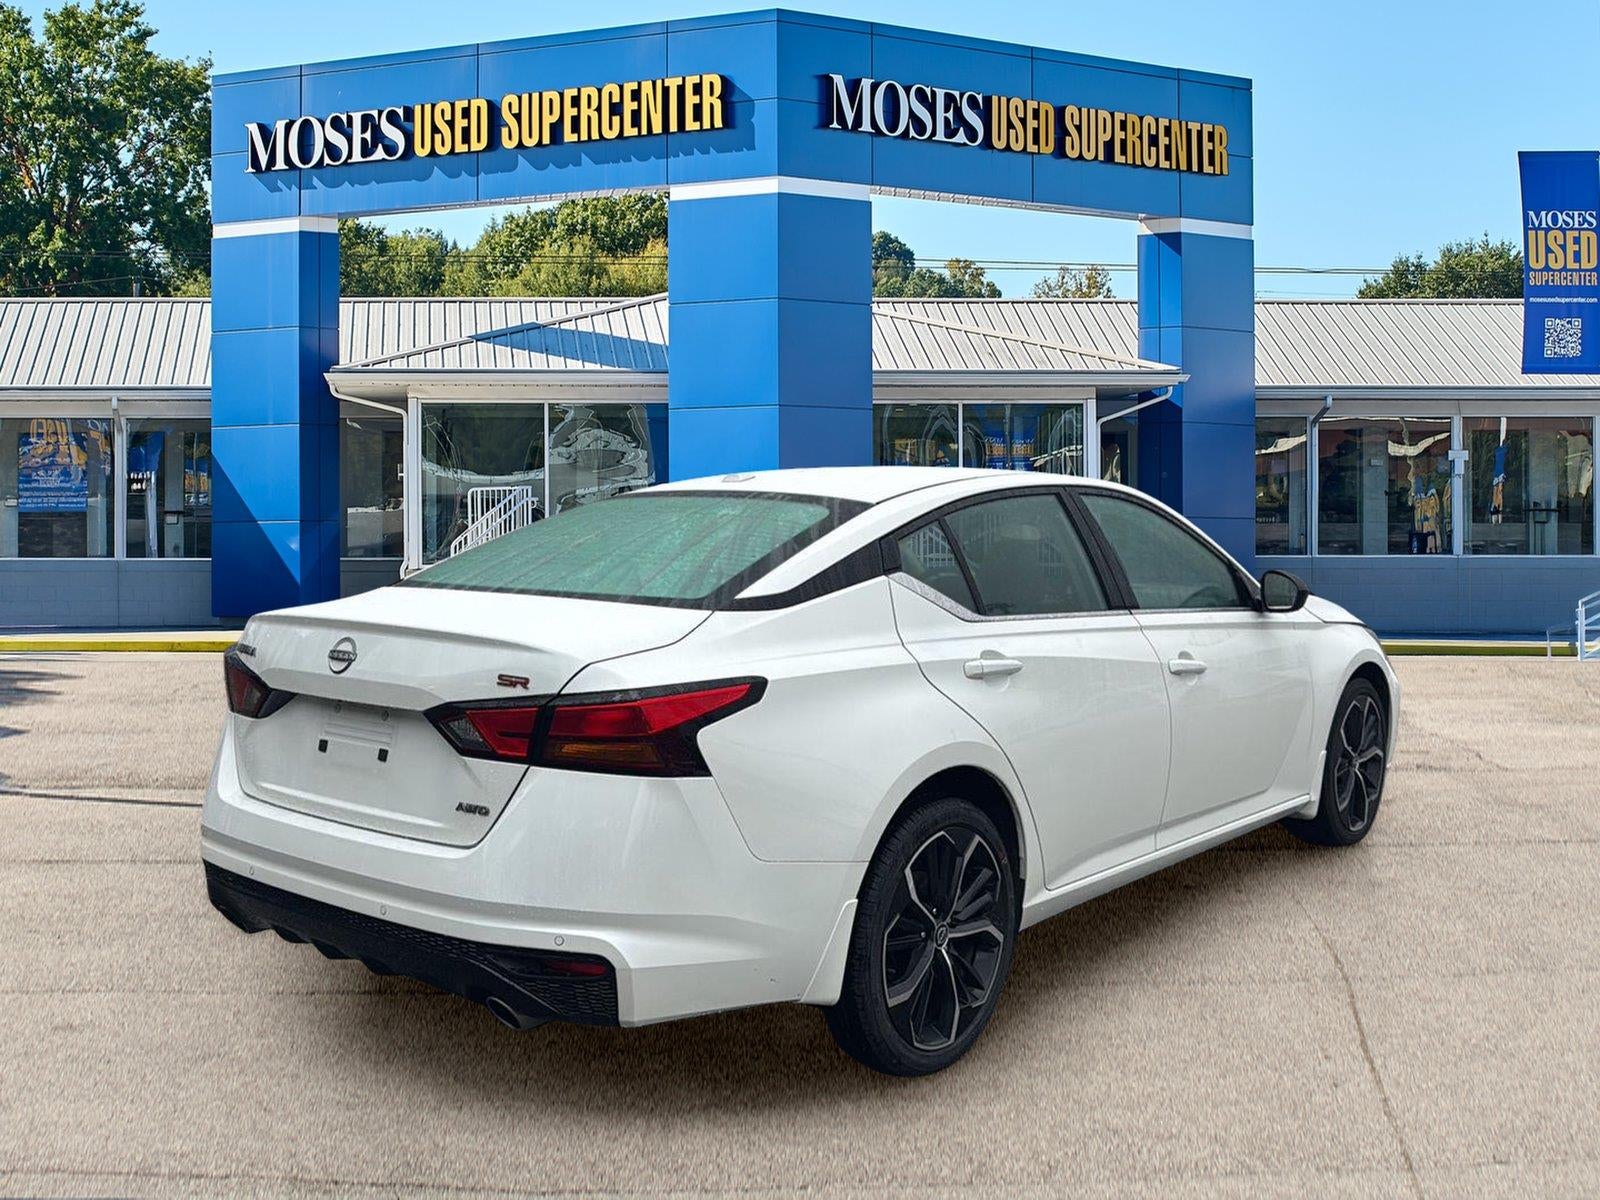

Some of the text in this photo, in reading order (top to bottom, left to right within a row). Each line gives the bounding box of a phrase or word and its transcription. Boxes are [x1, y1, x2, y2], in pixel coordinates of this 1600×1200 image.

[244, 73, 723, 174] MOSES USED SUPERCENTER
[828, 73, 1229, 176] MOSES USED SUPERCENTER
[1527, 210, 1597, 229] MOSES
[1528, 230, 1598, 270] USED
[1529, 271, 1598, 286] SUPERCENTER
[497, 673, 529, 690] SR
